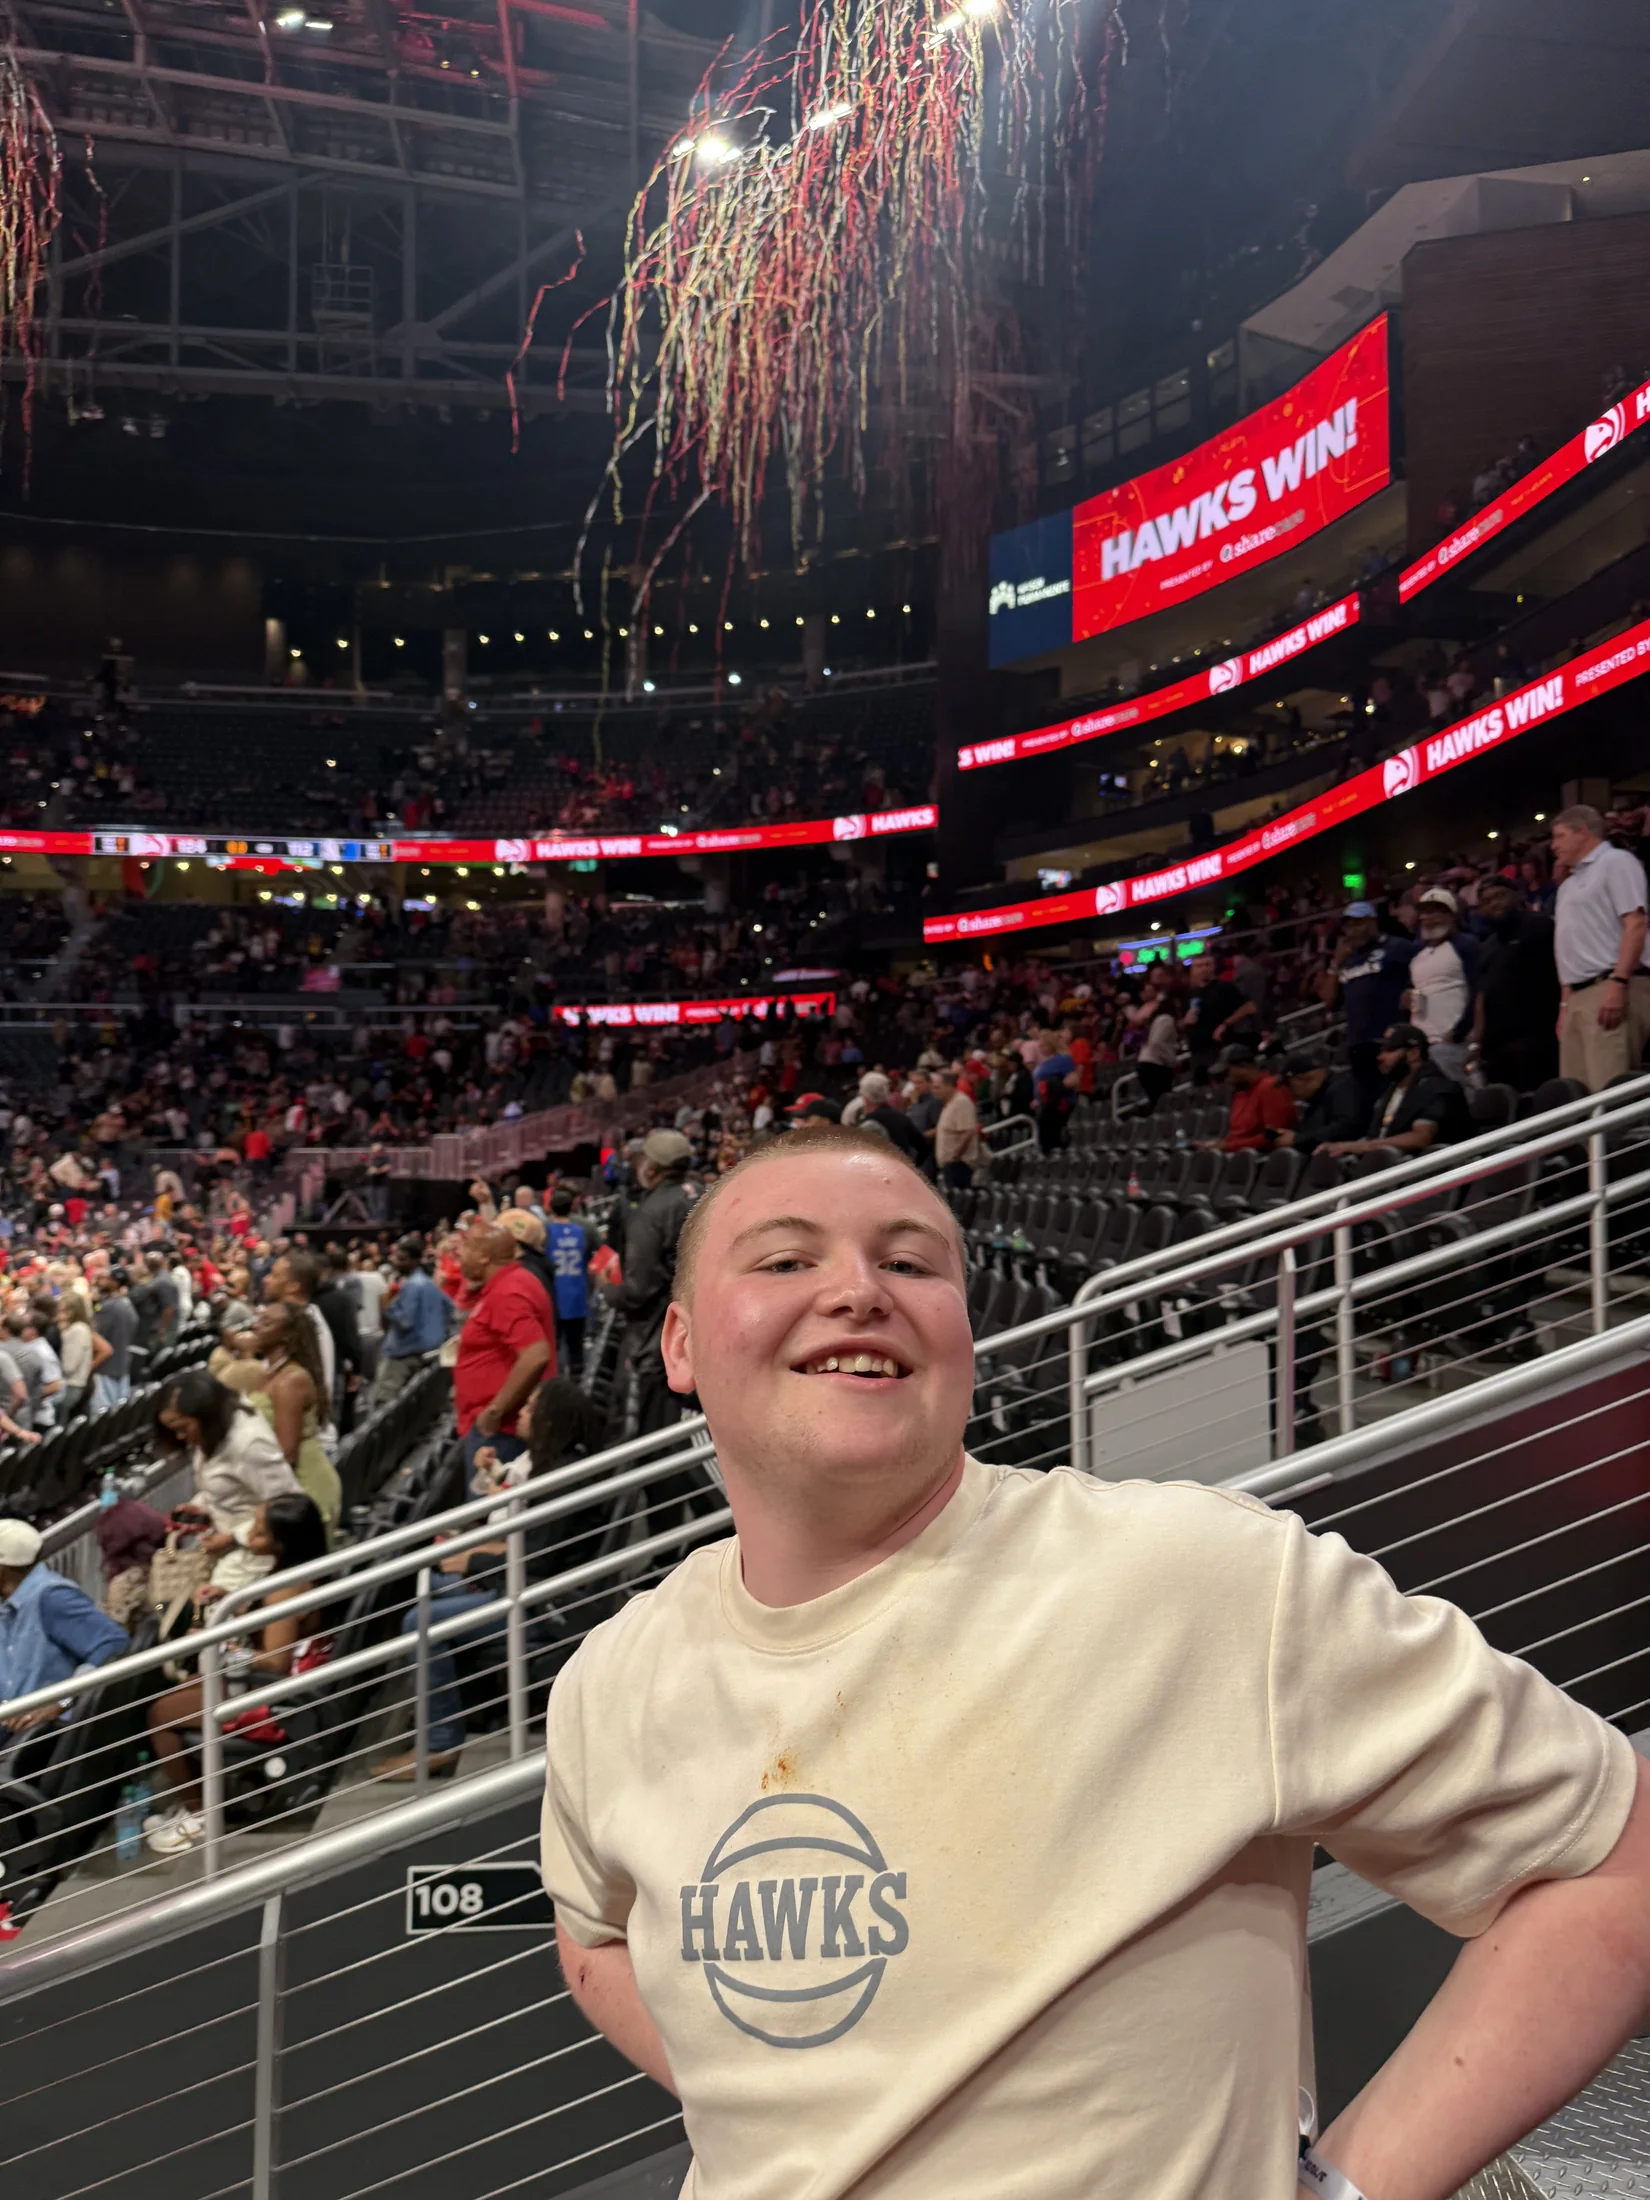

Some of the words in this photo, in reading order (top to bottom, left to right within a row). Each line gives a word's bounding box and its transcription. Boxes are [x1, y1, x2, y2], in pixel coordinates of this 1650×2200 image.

[1101, 467, 1257, 580] HAWKS
[1261, 397, 1358, 502] WIN!
[1249, 627, 1307, 675] HAWKS
[1306, 603, 1347, 642] WIN!
[1575, 648, 1636, 687] PRESENTED
[1427, 708, 1504, 772] HAWKS
[1504, 675, 1564, 730] WIN!
[974, 739, 1016, 764] WIN!
[871, 809, 935, 834] HAWKS
[536, 839, 600, 858] HAWKS
[600, 838, 642, 856] WIN!
[1131, 866, 1187, 901] HAWKS
[1186, 853, 1223, 885] WIN!
[552, 1249, 582, 1276] 32
[415, 1882, 484, 1916] 108
[680, 1871, 909, 1962] HAWKS
